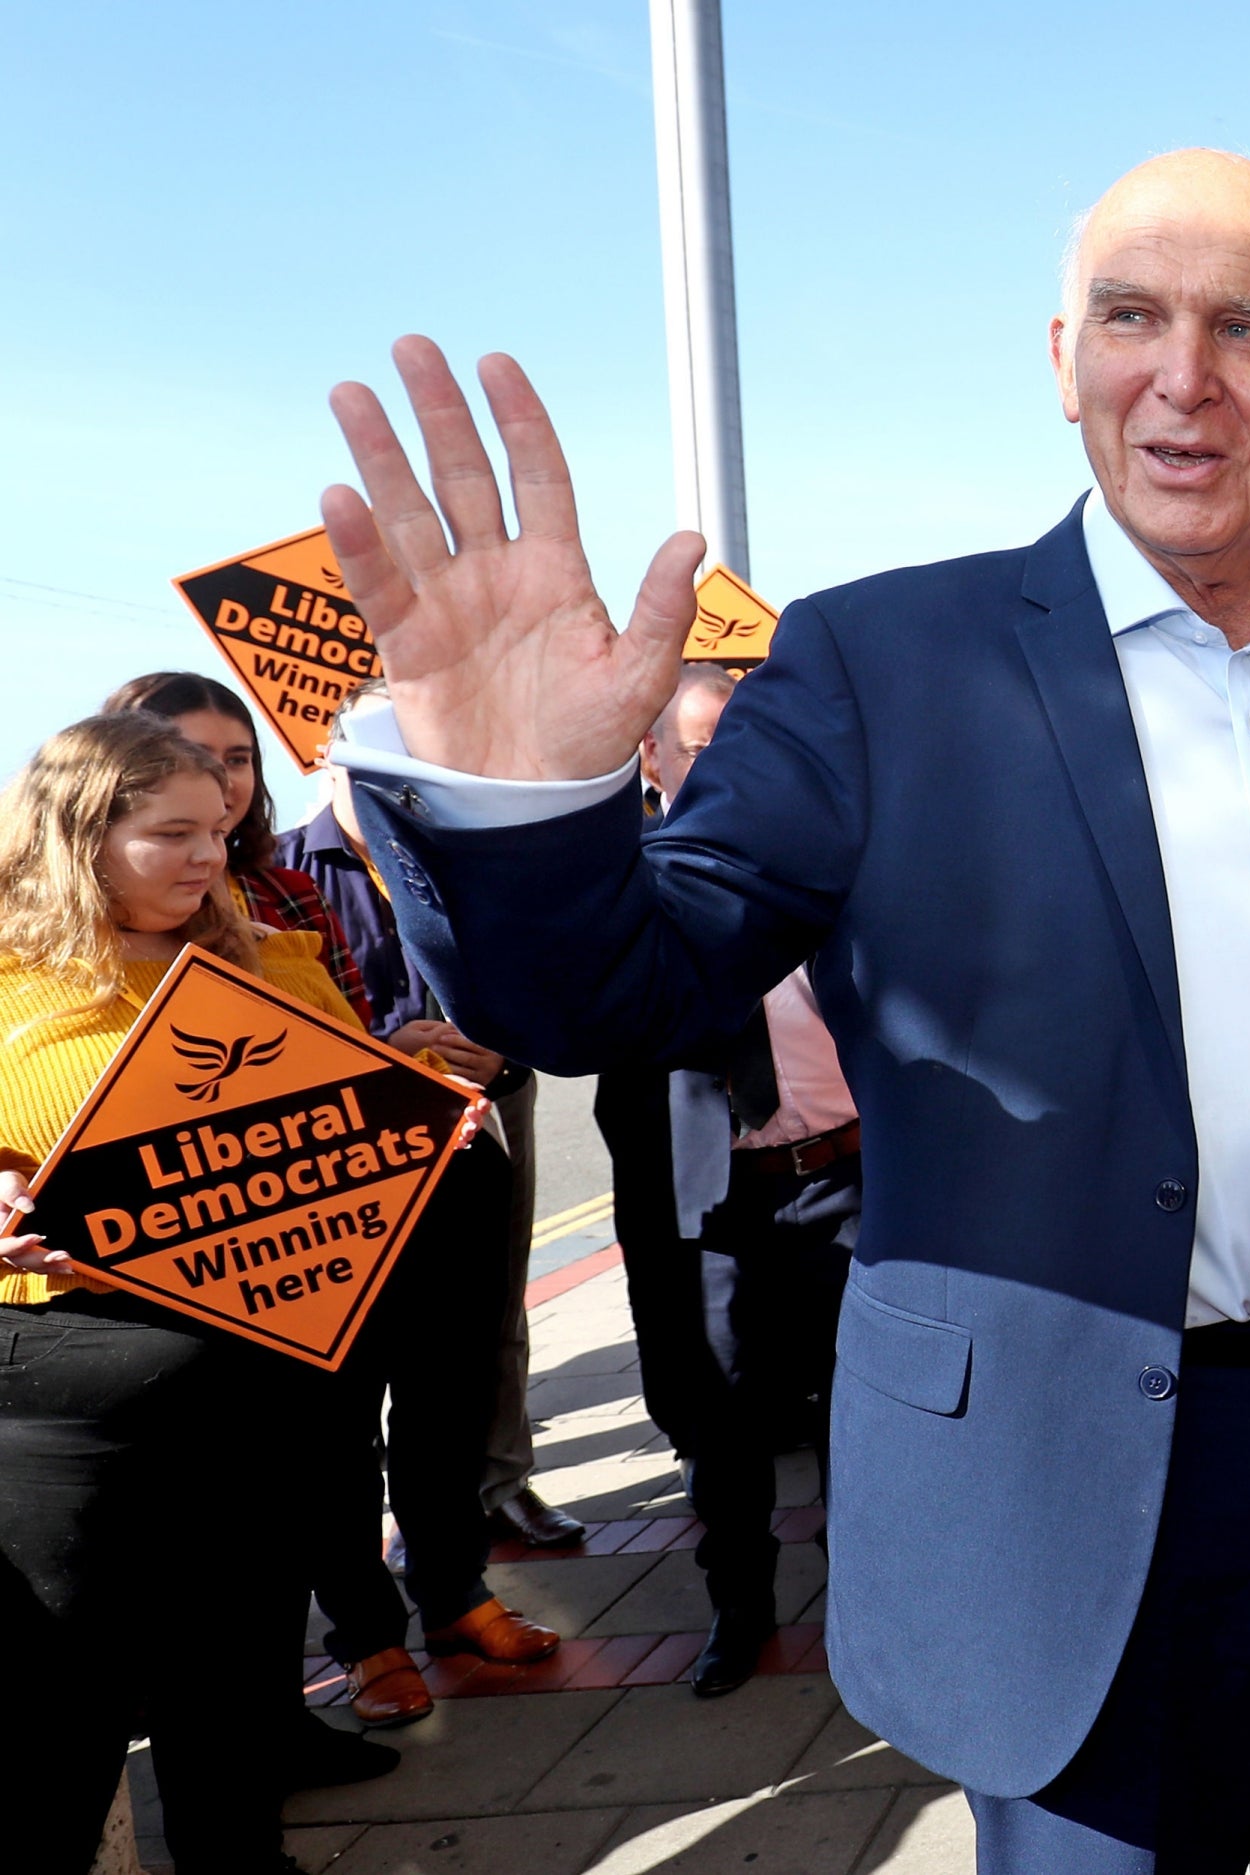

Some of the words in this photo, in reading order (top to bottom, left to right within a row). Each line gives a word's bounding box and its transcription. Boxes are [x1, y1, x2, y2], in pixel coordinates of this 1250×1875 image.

[138, 1086, 365, 1190] Liberal
[84, 1124, 435, 1258] Democrats
[172, 1200, 388, 1289] Winning
[239, 1256, 354, 1316] here
